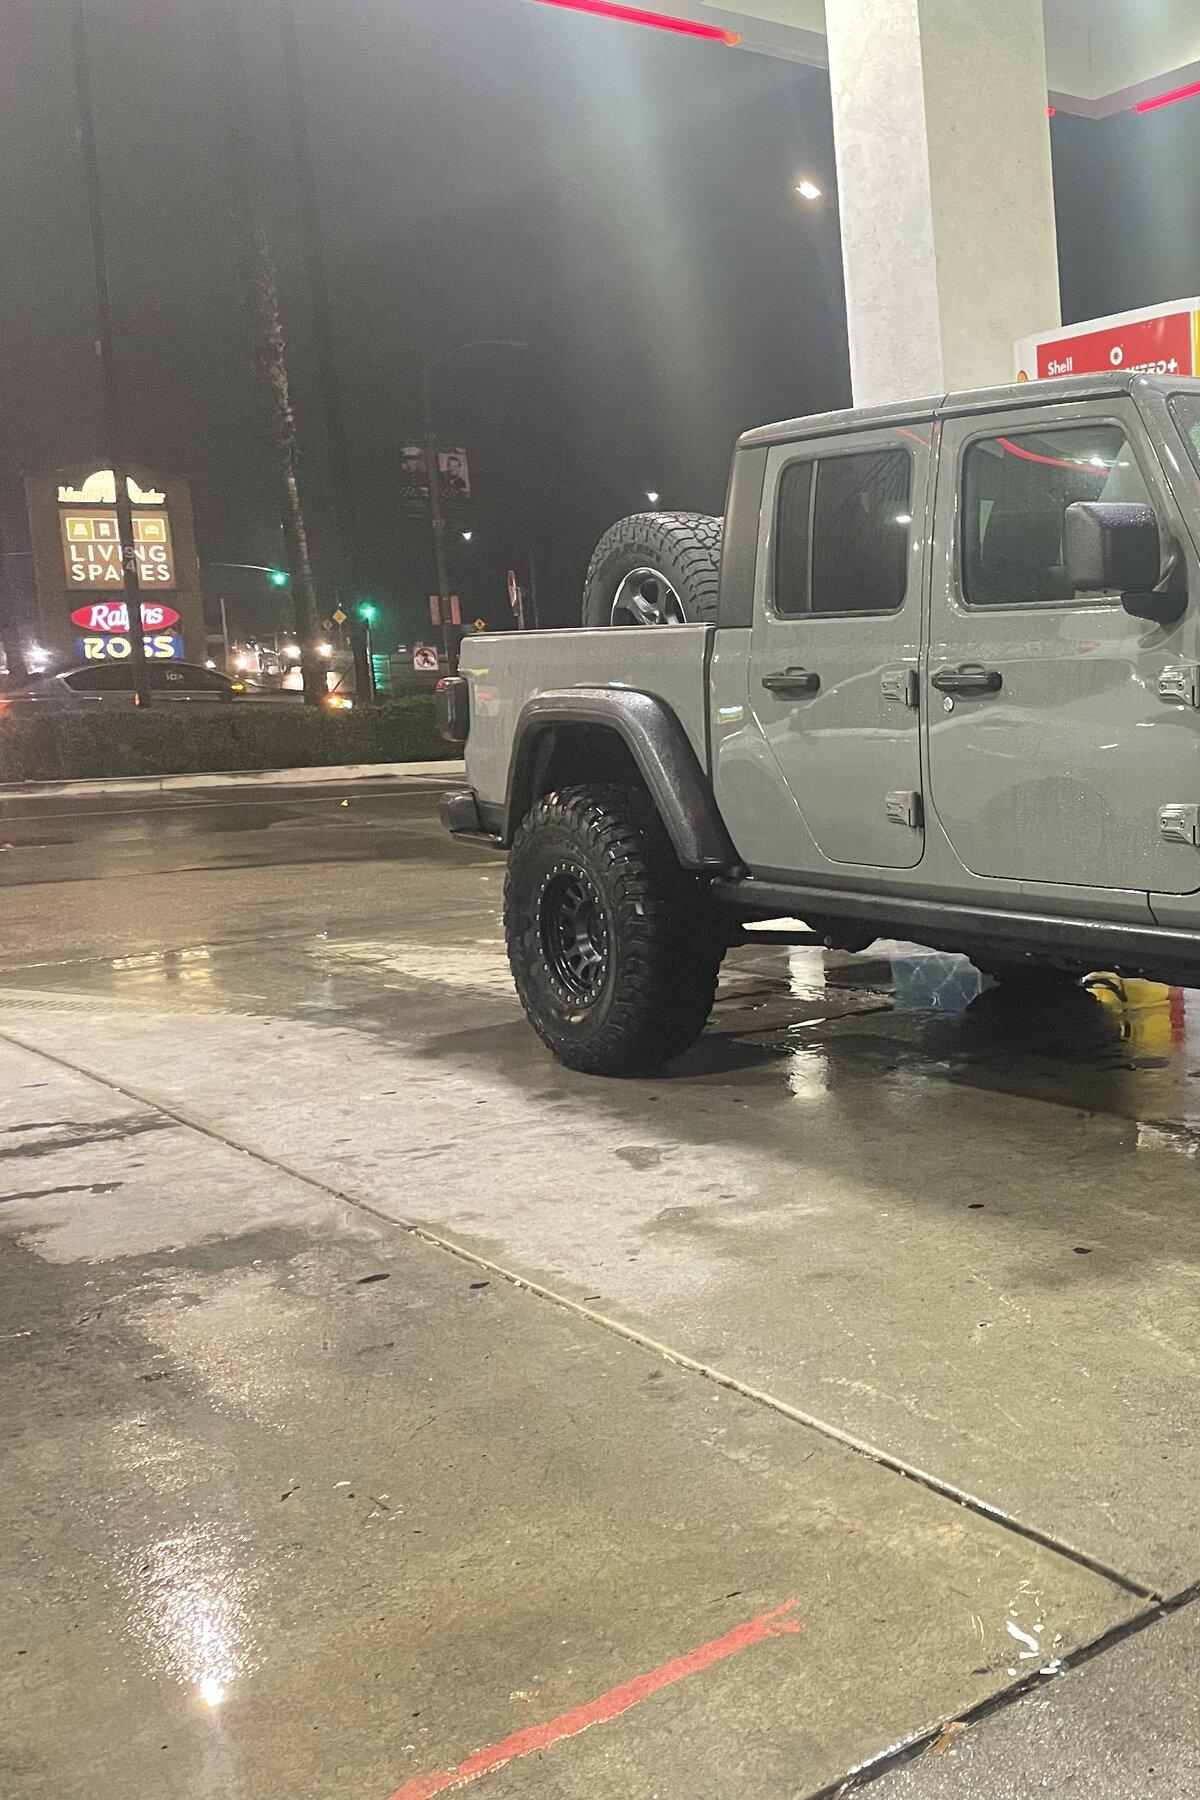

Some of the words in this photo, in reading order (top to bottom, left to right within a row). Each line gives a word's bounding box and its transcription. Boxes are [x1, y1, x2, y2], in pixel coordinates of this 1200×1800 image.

[1047, 356, 1073, 376] Shell
[70, 544, 167, 562] LIVING
[71, 563, 171, 582] SPAES
[83, 636, 175, 659] ROSS
